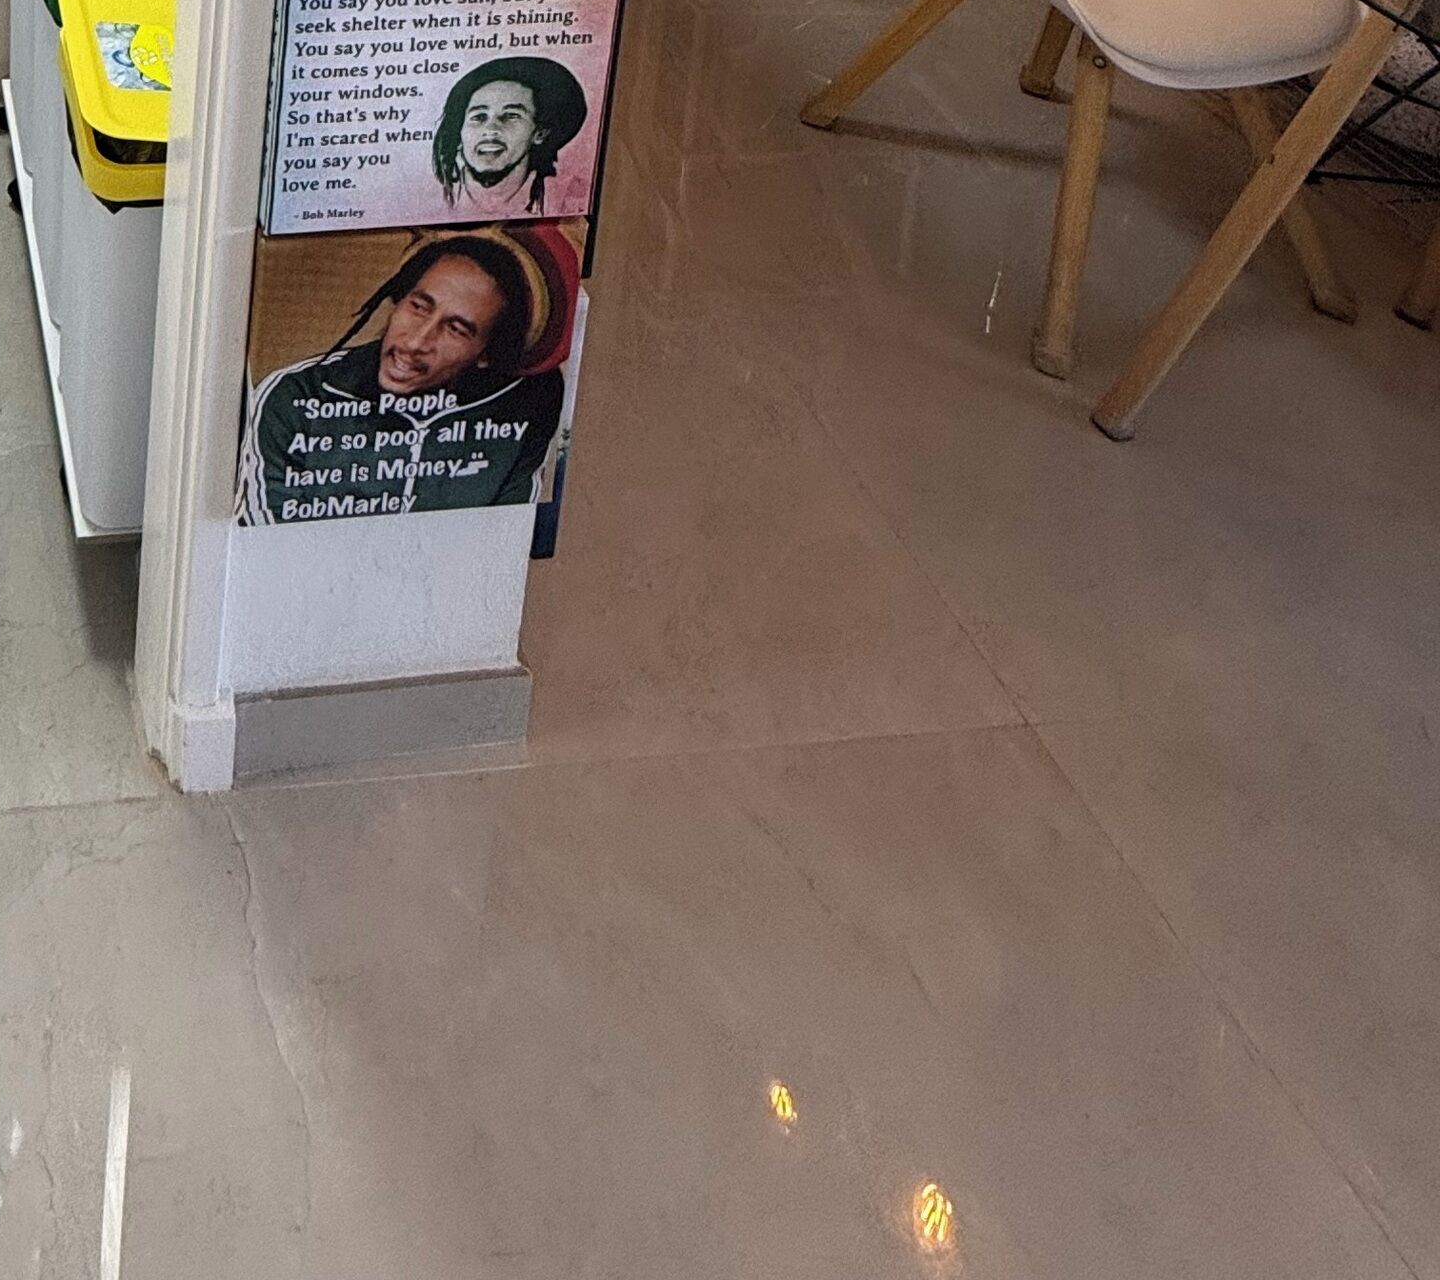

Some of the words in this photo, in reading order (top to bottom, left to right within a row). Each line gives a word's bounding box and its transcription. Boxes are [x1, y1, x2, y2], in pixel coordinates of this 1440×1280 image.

[287, 110, 309, 126] So
[316, 107, 367, 124] that's
[373, 108, 411, 123] why
[302, 210, 324, 220] Bob
[327, 208, 366, 219] Marley
[378, 391, 458, 416] People
[287, 433, 333, 455] Are
[340, 433, 367, 450] so
[374, 428, 429, 448] poor
[437, 422, 466, 444] all
[474, 419, 529, 441] they
[282, 492, 418, 520] BobMarley
